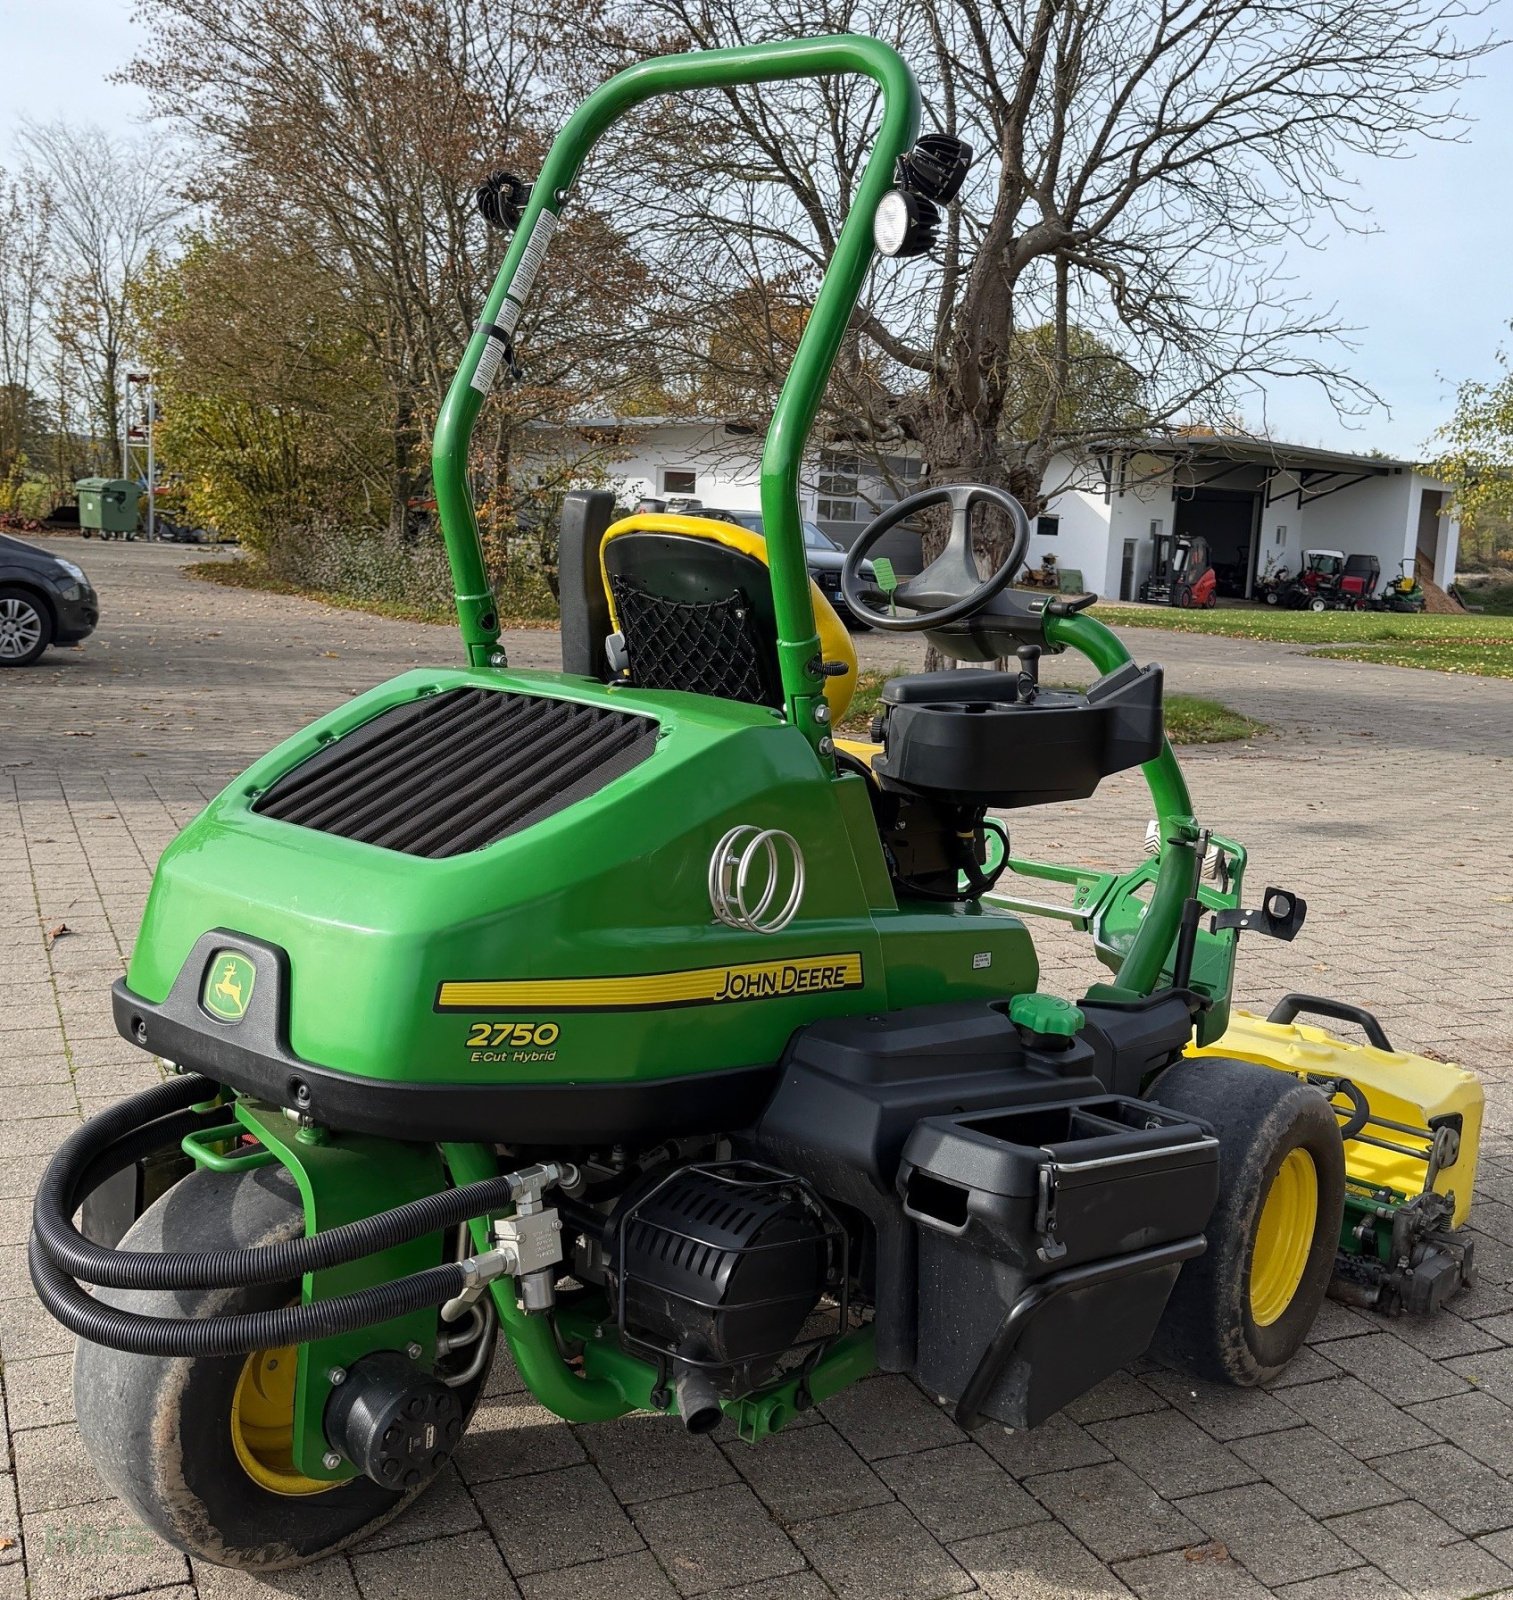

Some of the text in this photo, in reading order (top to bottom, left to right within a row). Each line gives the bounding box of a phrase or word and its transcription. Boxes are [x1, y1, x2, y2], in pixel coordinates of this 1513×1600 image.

[714, 965, 848, 999] JOHN DEERE
[466, 1023, 560, 1047] 2750
[470, 1050, 557, 1064] E-Cut Hybrid
